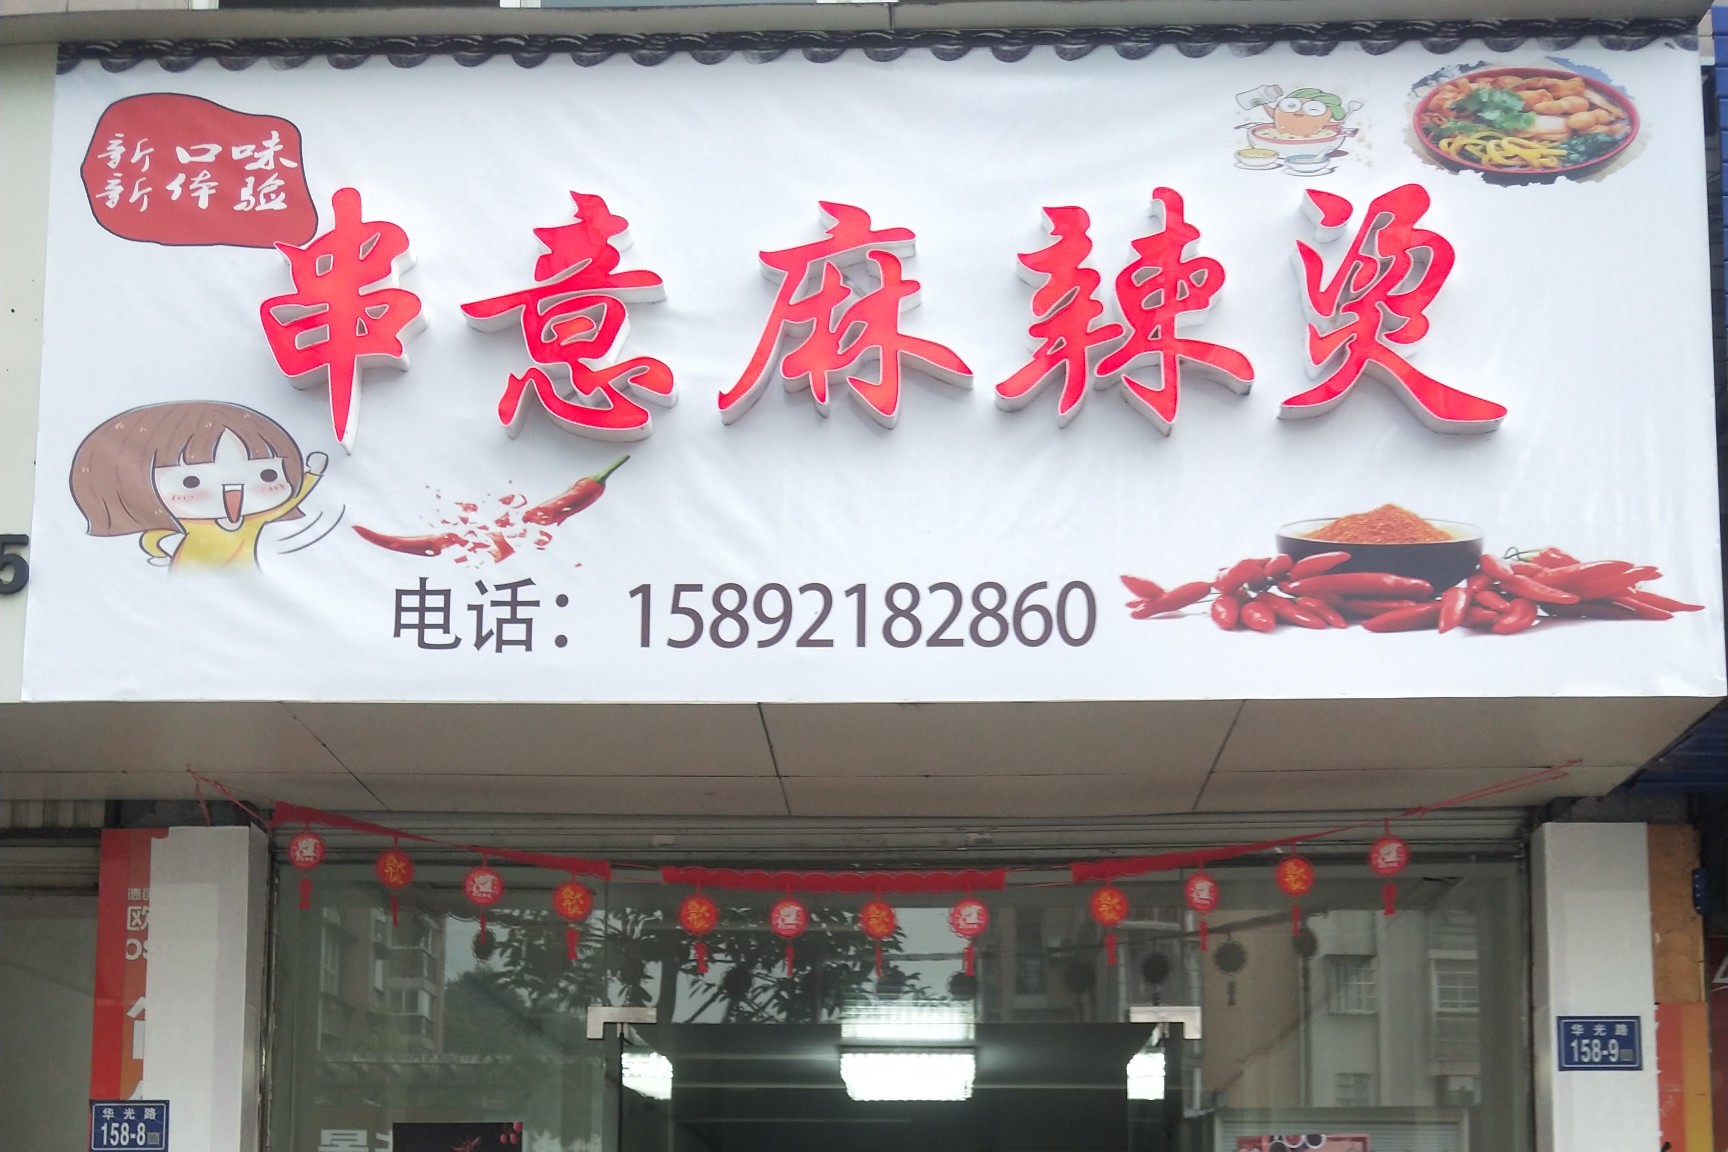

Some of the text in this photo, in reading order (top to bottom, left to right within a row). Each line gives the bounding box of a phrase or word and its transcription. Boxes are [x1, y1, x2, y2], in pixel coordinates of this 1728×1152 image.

[97, 132, 298, 172] 新口味
[95, 170, 288, 212] 新体验
[260, 183, 1509, 450] 串意麻辣烫
[1570, 1023, 1629, 1037] 华光路
[1570, 1038, 1619, 1063] 158-9
[102, 1107, 157, 1120] 华光路
[101, 1122, 146, 1146] 158-8
